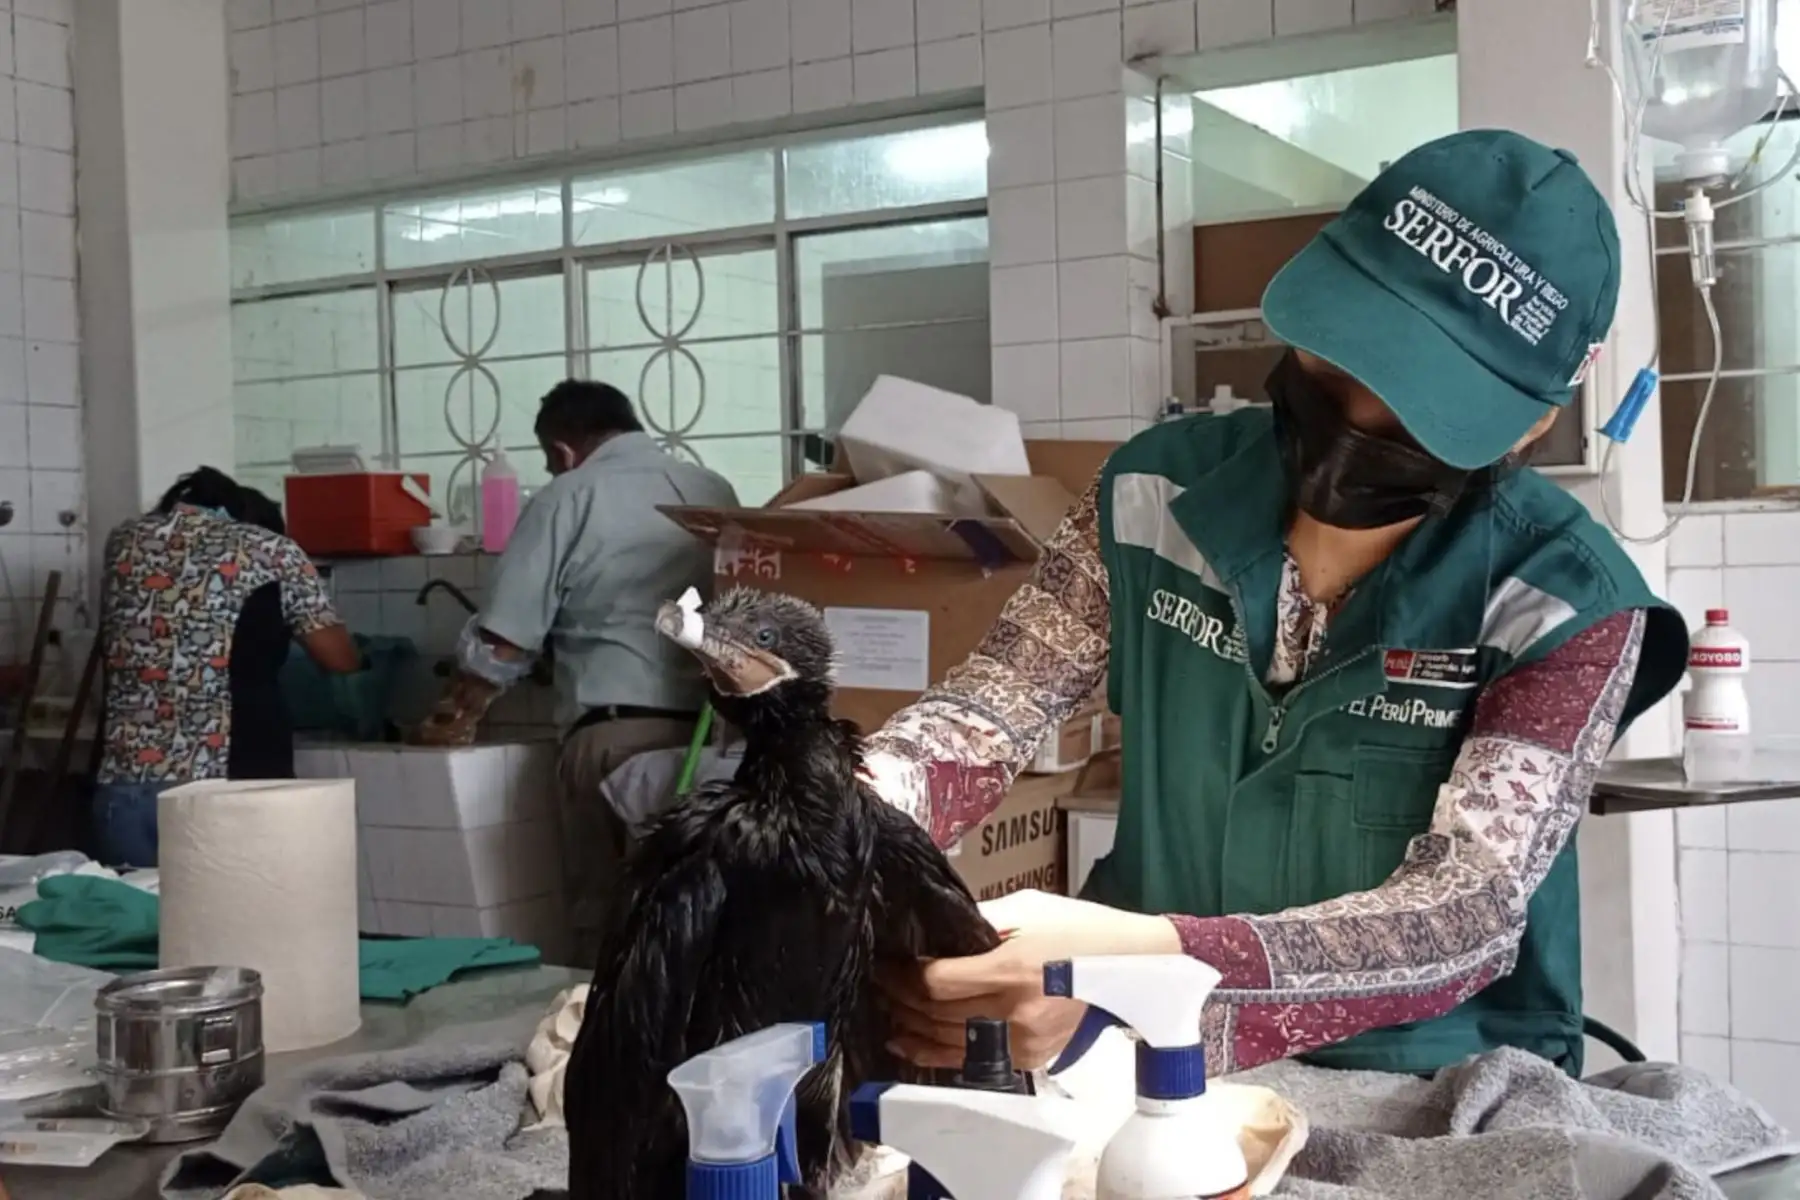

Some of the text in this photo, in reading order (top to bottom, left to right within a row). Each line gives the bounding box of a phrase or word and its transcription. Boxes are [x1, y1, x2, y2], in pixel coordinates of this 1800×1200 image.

[1383, 199, 1523, 325] SERFOR
[1408, 185, 1459, 223] MINISTERIO
[1456, 216, 1475, 233] DE
[1470, 227, 1537, 284] AGRICULTURA
[1532, 277, 1546, 291] Y
[1146, 588, 1227, 658] SERFOR
[981, 807, 1056, 857] SAMSU
